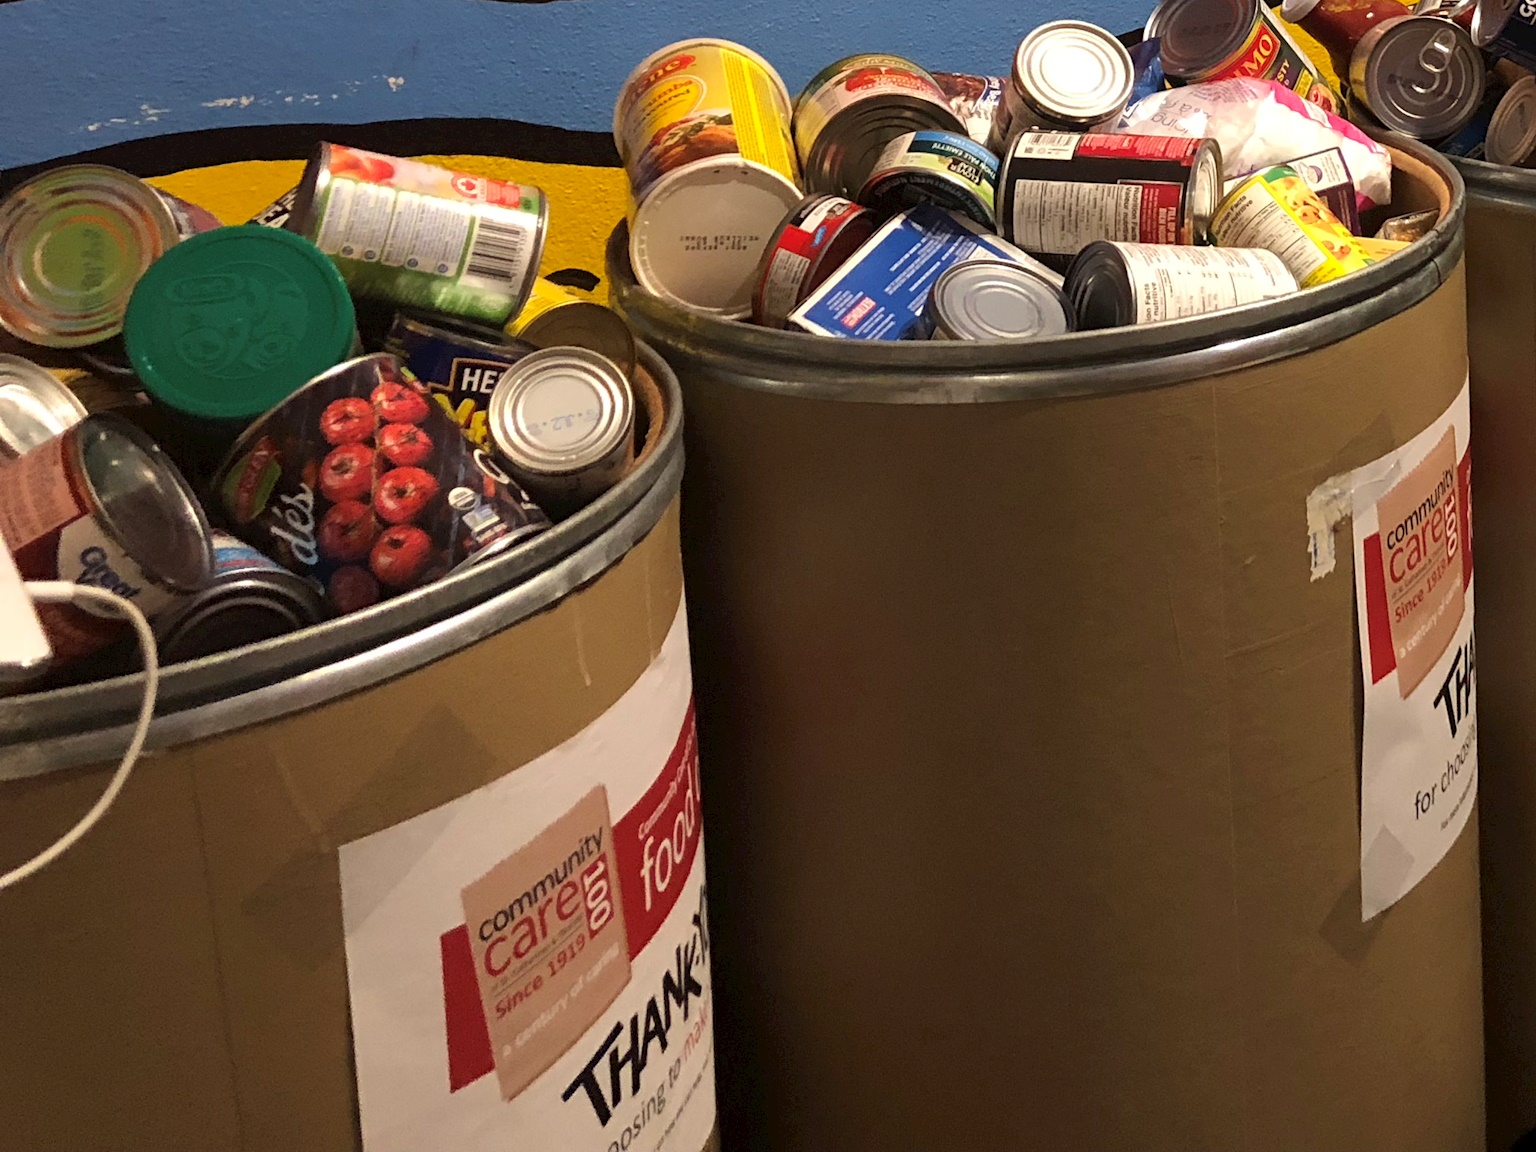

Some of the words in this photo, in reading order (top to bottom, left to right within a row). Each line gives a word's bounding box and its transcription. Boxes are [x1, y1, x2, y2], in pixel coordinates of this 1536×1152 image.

[949, 163, 980, 184] CLOVER
[1386, 464, 1454, 550] community
[1444, 493, 1459, 558] 100
[1389, 506, 1444, 584] care
[1394, 588, 1424, 624] Since
[1426, 557, 1445, 595] 1919
[640, 761, 695, 913] food
[1413, 782, 1438, 820] for
[478, 826, 603, 942] community
[582, 860, 611, 931] 100
[484, 879, 582, 978] care
[494, 975, 543, 1019] Since
[548, 932, 586, 978] 1919
[668, 1057, 680, 1090] to
